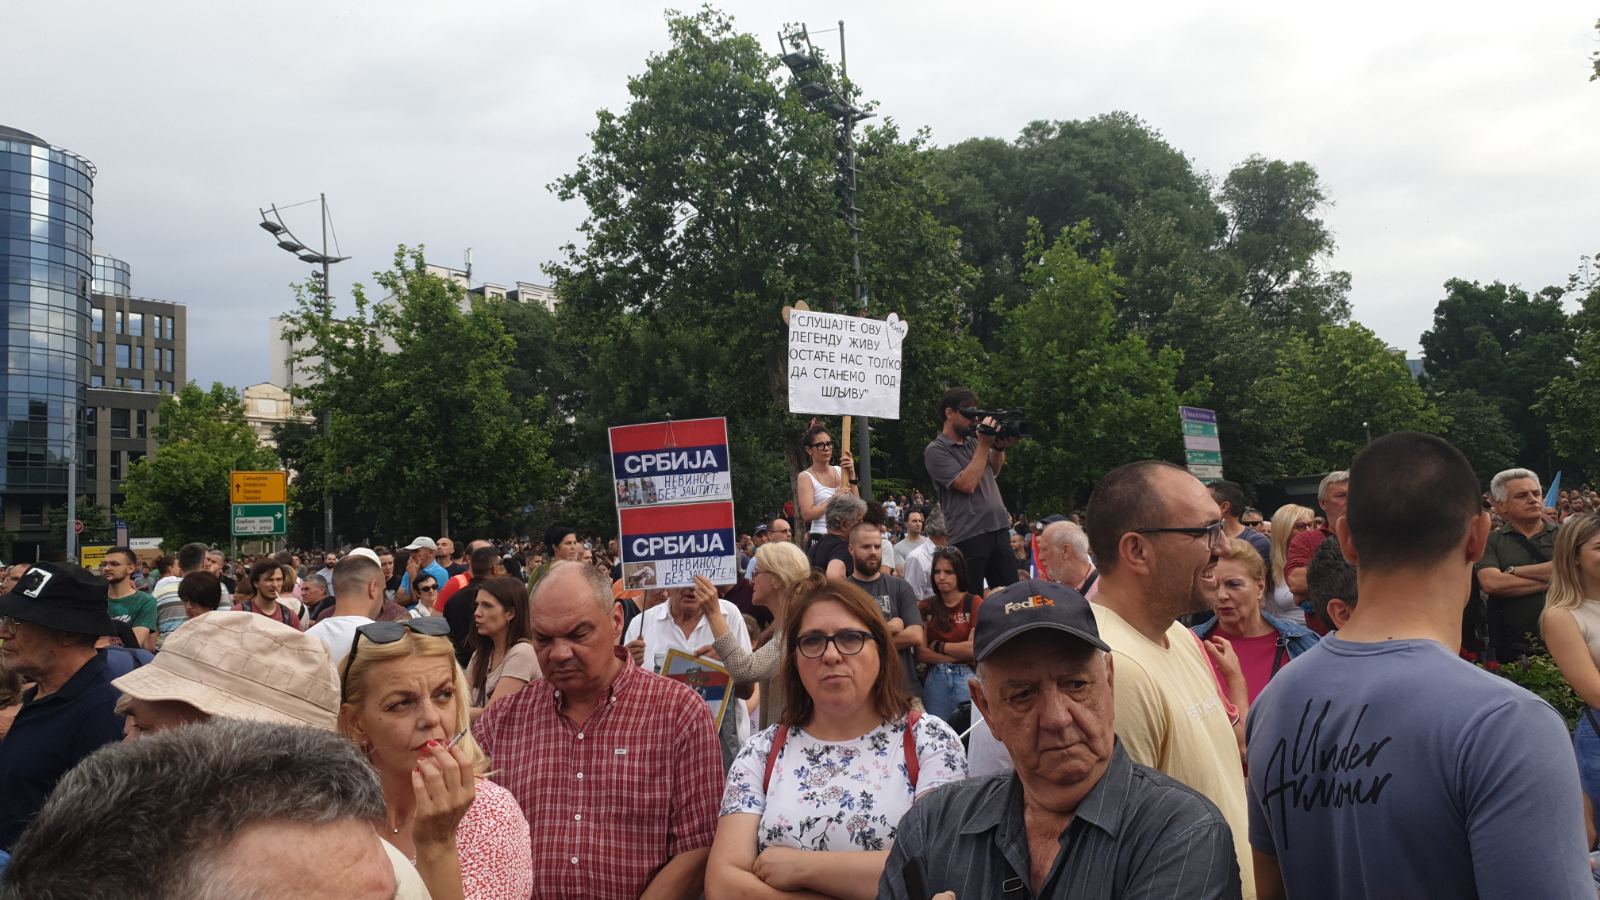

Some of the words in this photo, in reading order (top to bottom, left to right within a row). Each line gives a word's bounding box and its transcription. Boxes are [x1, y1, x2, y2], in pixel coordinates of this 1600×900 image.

[860, 322, 881, 336] ОВУ
[790, 330, 842, 347] ЛЕГЕНДУ
[848, 337, 880, 351] ЖИВУ
[789, 348, 836, 363] ОСТАЋЕ
[840, 353, 863, 366] НАС
[790, 365, 808, 379] ДА
[813, 367, 866, 383] СТАНЕМО
[875, 374, 896, 387] ПОД
[623, 449, 718, 474] СРБИЈА
[664, 472, 718, 488] НЕВИНОСТ
[657, 487, 677, 501] БЕЗ
[681, 483, 720, 497] ЗАШТИТЕ
[632, 533, 725, 557] СРБИЈА
[671, 556, 722, 572] НЕВИНОСТ
[665, 570, 684, 585] БЕЗ
[1004, 595, 1056, 615] FedEx
[1291, 698, 1392, 775] Under
[1262, 737, 1393, 850] Armour
